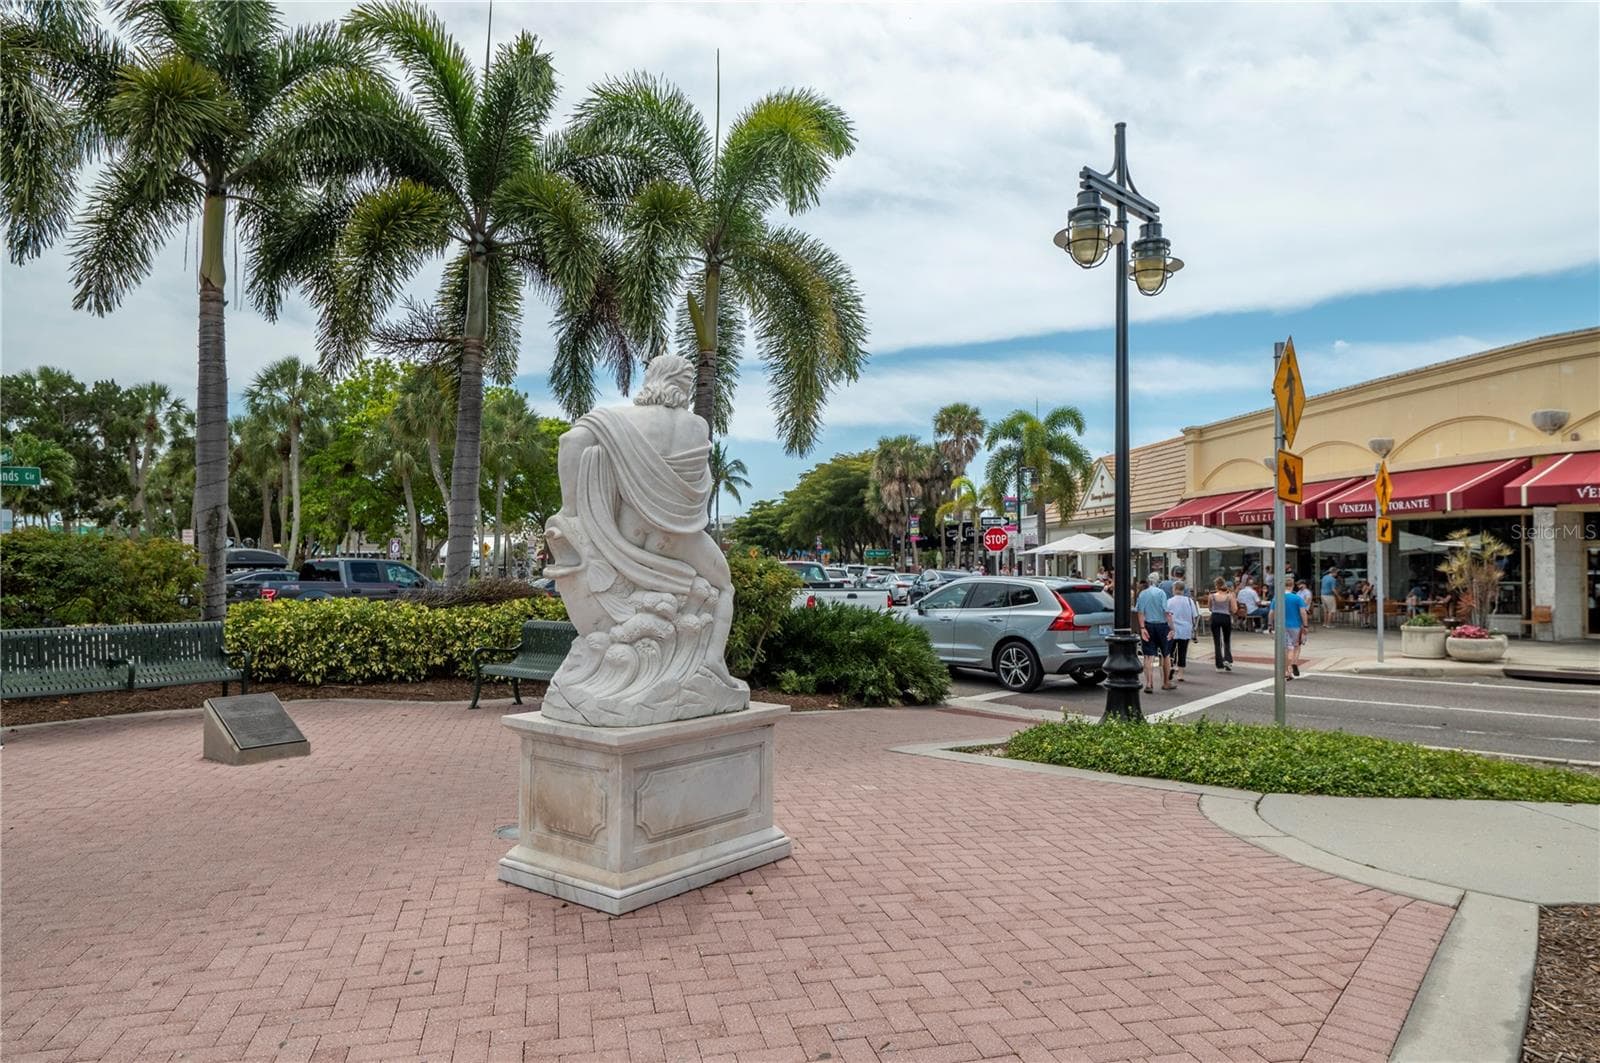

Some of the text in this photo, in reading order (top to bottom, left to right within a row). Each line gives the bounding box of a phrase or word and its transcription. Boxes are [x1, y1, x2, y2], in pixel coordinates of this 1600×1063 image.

[0, 470, 35, 481] nds Cir
[1576, 485, 1600, 498] VE
[1338, 498, 1430, 513] VENEZIA TORANTE
[1239, 513, 1272, 523] VENEZI
[985, 534, 1007, 545] STOP
